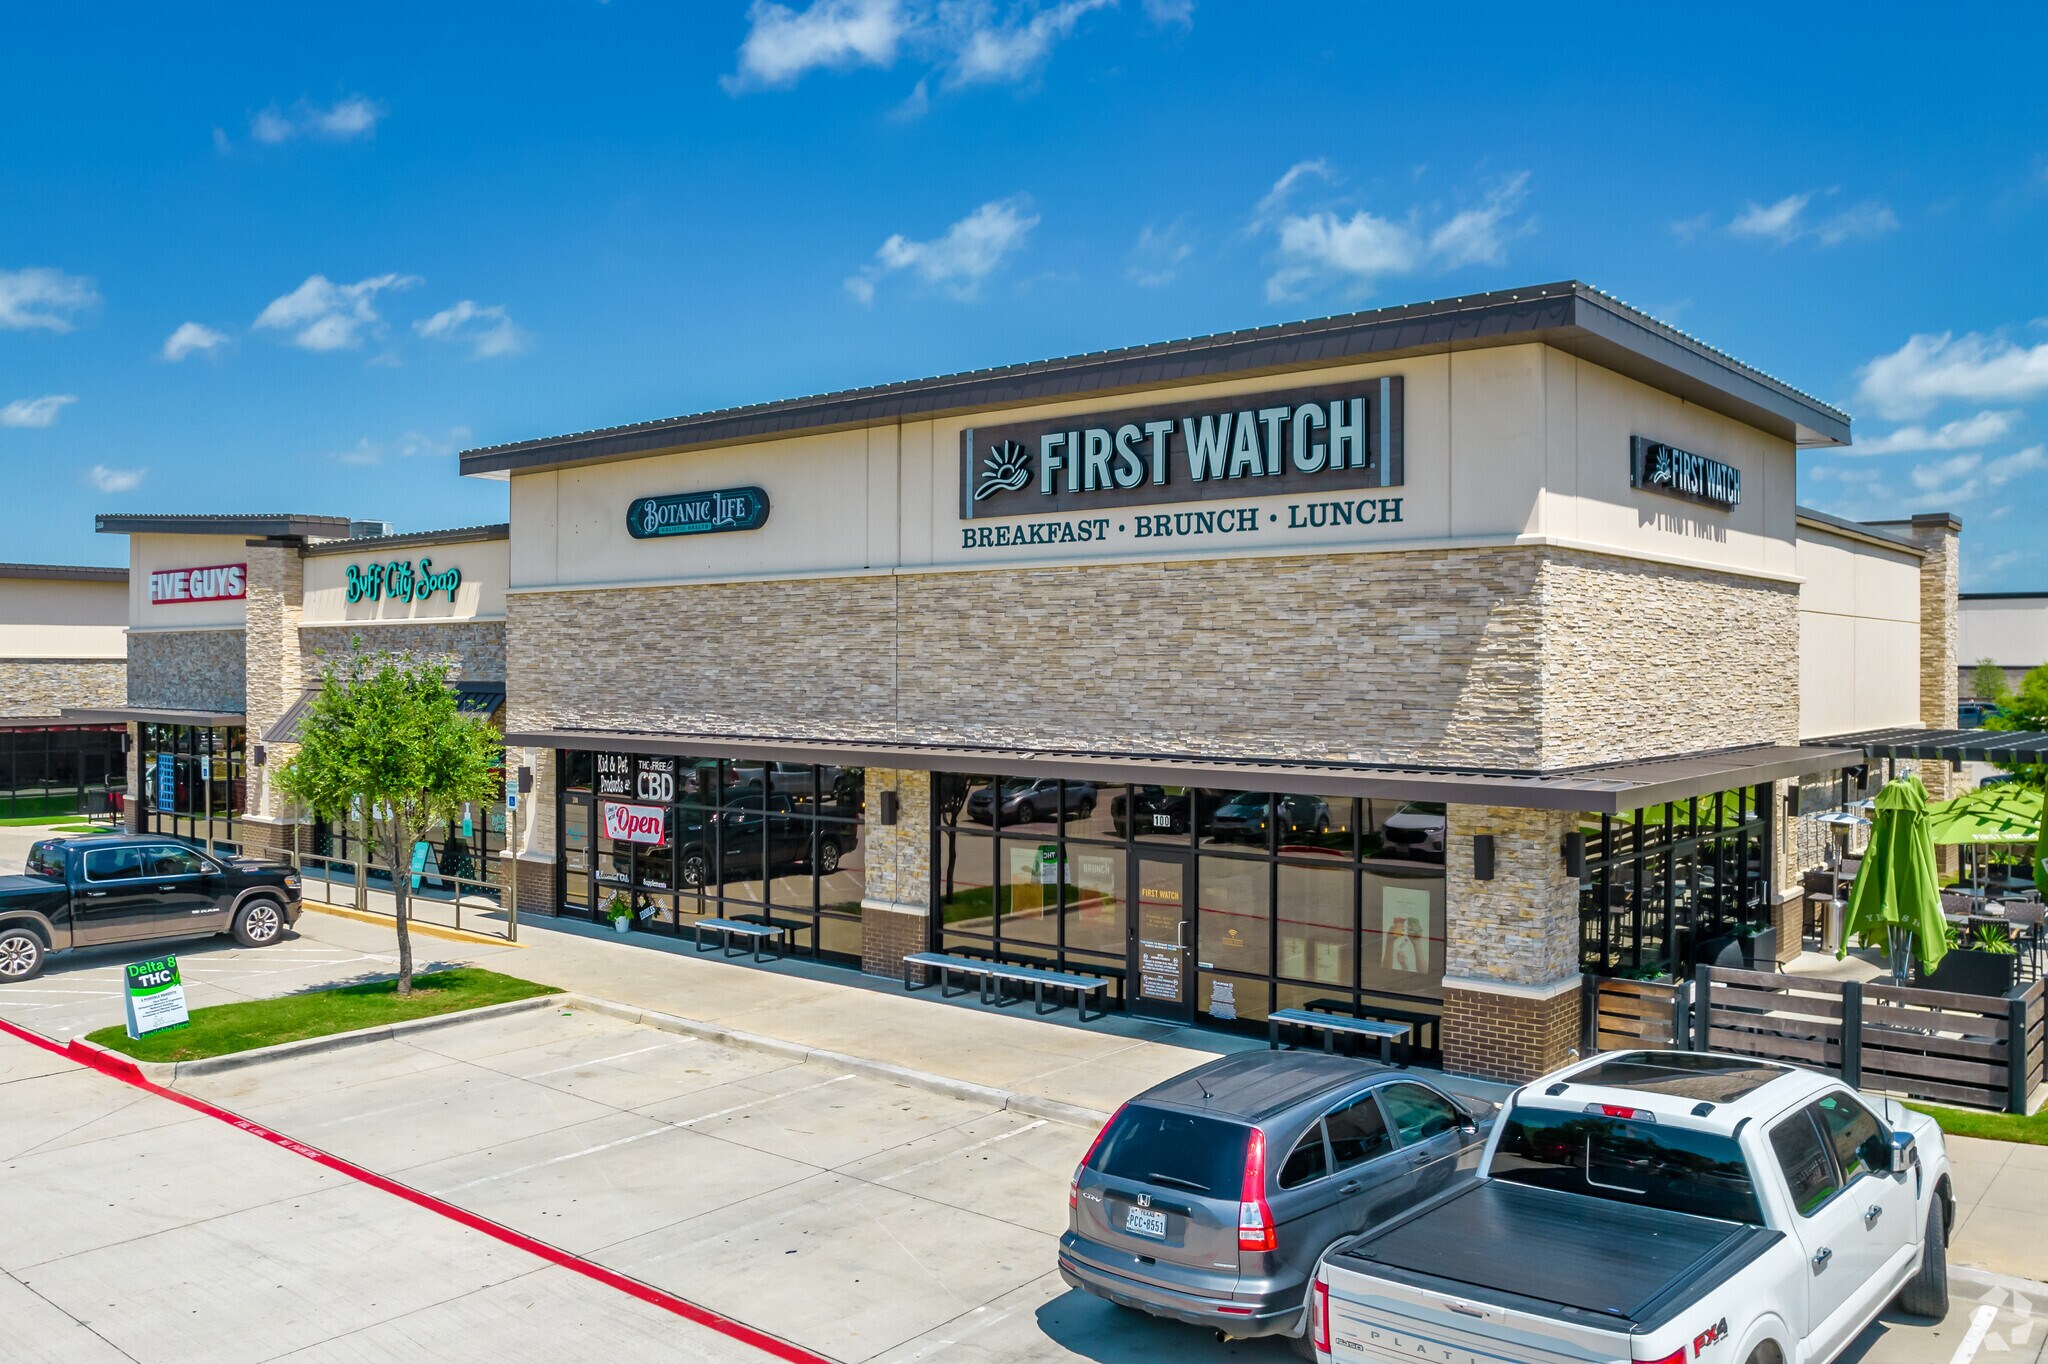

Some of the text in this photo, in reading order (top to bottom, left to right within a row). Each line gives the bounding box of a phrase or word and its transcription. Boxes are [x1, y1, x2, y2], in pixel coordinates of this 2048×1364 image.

[1040, 397, 1367, 496] FIRST WATCH
[1672, 449, 1740, 504] FIRST WATCH
[643, 492, 746, 533] BOTANIC LIFE
[962, 498, 1405, 549] BREAKFAST BRUNCH LUNCH
[148, 566, 246, 601] FIVE GUYS
[346, 558, 462, 603] Buff City Soap
[597, 754, 609, 772] Kid
[617, 755, 629, 773] Pet
[600, 774, 624, 793] Products
[637, 771, 674, 801] CBD
[616, 806, 660, 839] Open
[1154, 814, 1170, 827] 100
[1083, 863, 1110, 874] BRUNCH
[1141, 888, 1180, 900] FIRST WATCH
[128, 956, 176, 977] Delta 8
[138, 970, 172, 988] THC
[1140, 1210, 1156, 1218] TEXAS
[1693, 1316, 1729, 1360] FX4
